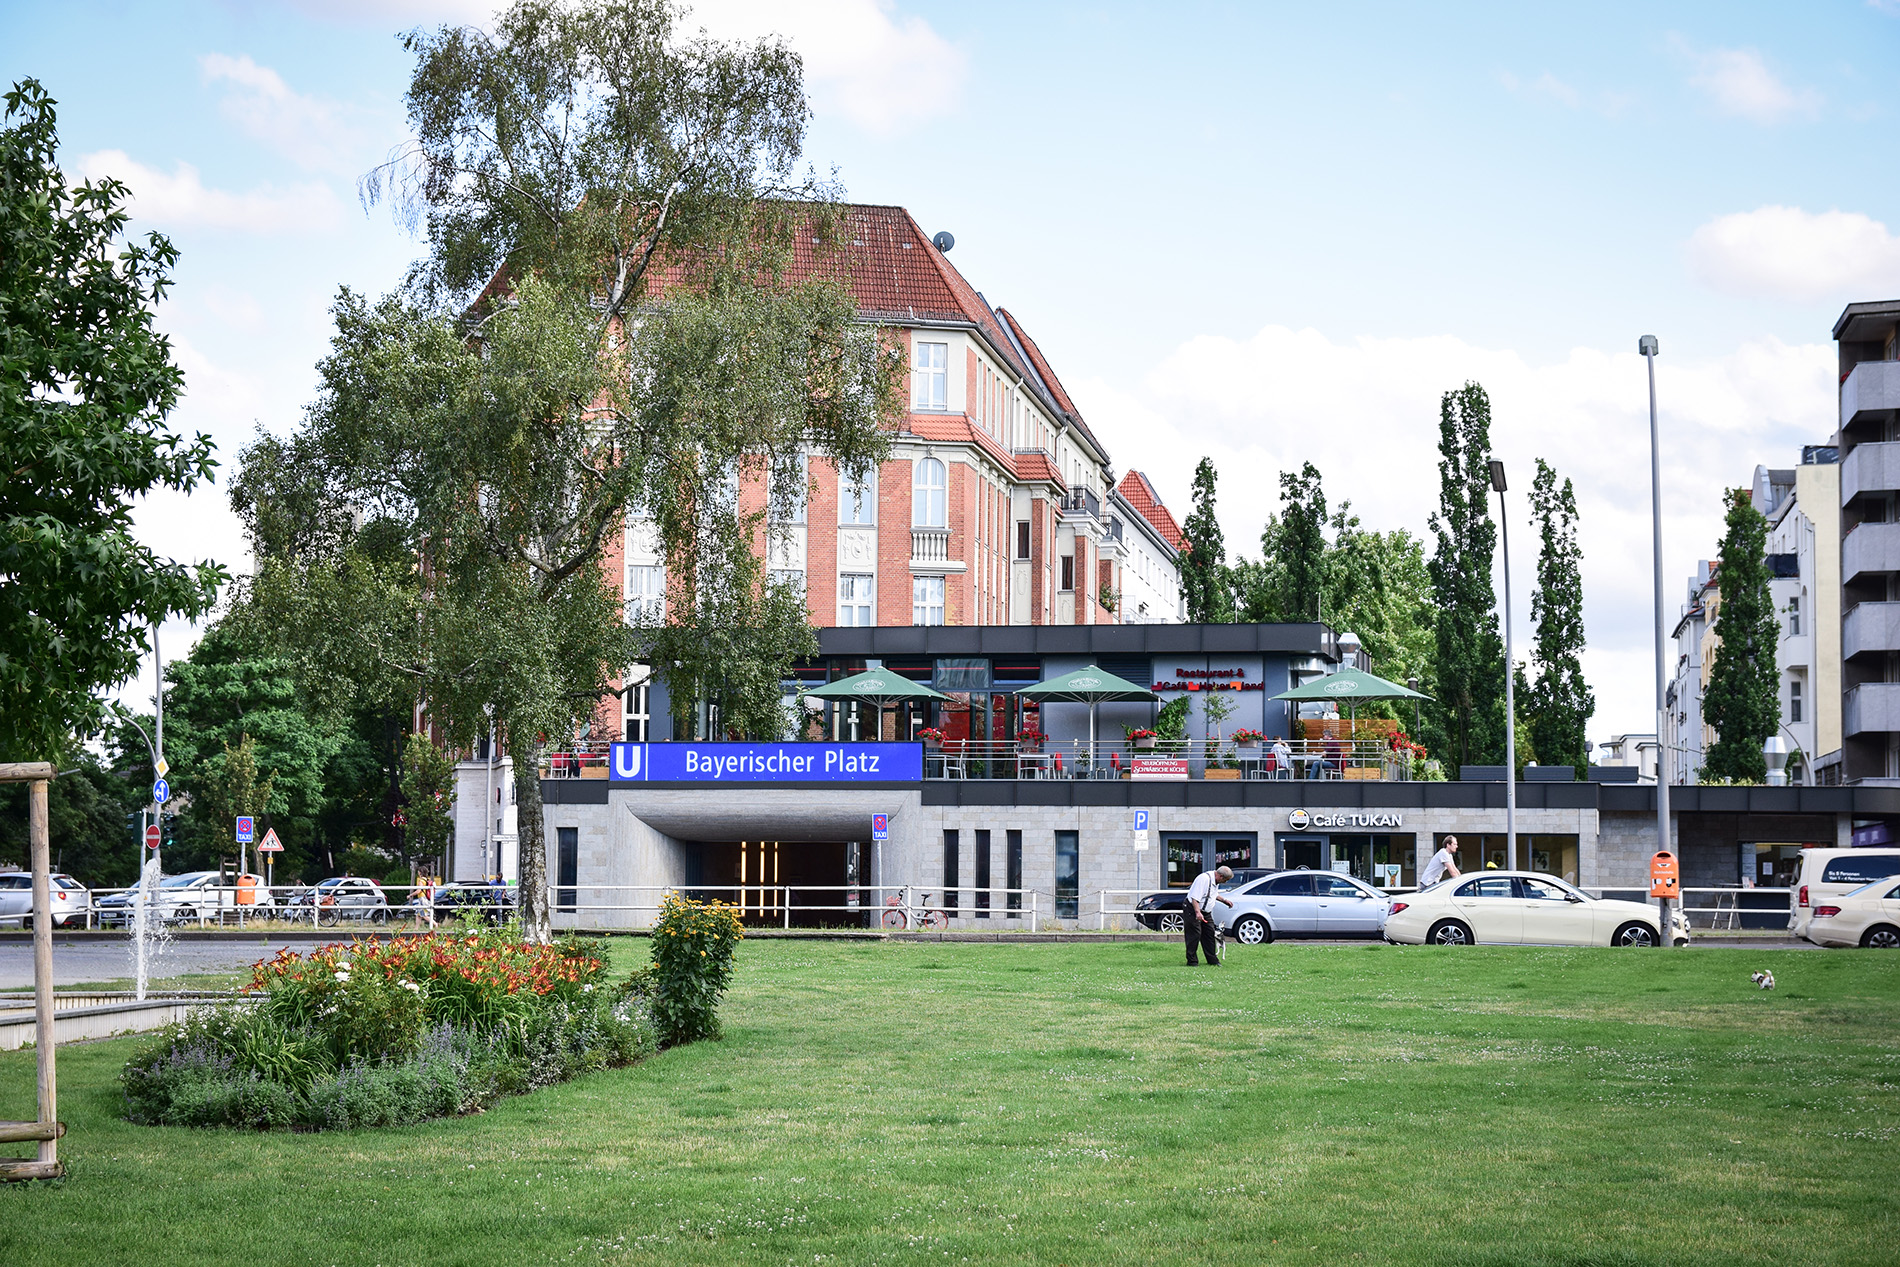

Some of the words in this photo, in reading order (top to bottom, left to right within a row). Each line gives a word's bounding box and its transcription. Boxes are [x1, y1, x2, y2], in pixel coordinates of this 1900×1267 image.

[1176, 668, 1234, 678] Restaurant
[1236, 668, 1244, 678] &
[1162, 681, 1187, 691] Café
[615, 745, 641, 778] U
[686, 749, 814, 778] Bayerischer
[825, 749, 880, 773] Platz
[1136, 812, 1146, 829] P
[1313, 814, 1346, 827] Café
[1350, 814, 1402, 827] TUKAN
